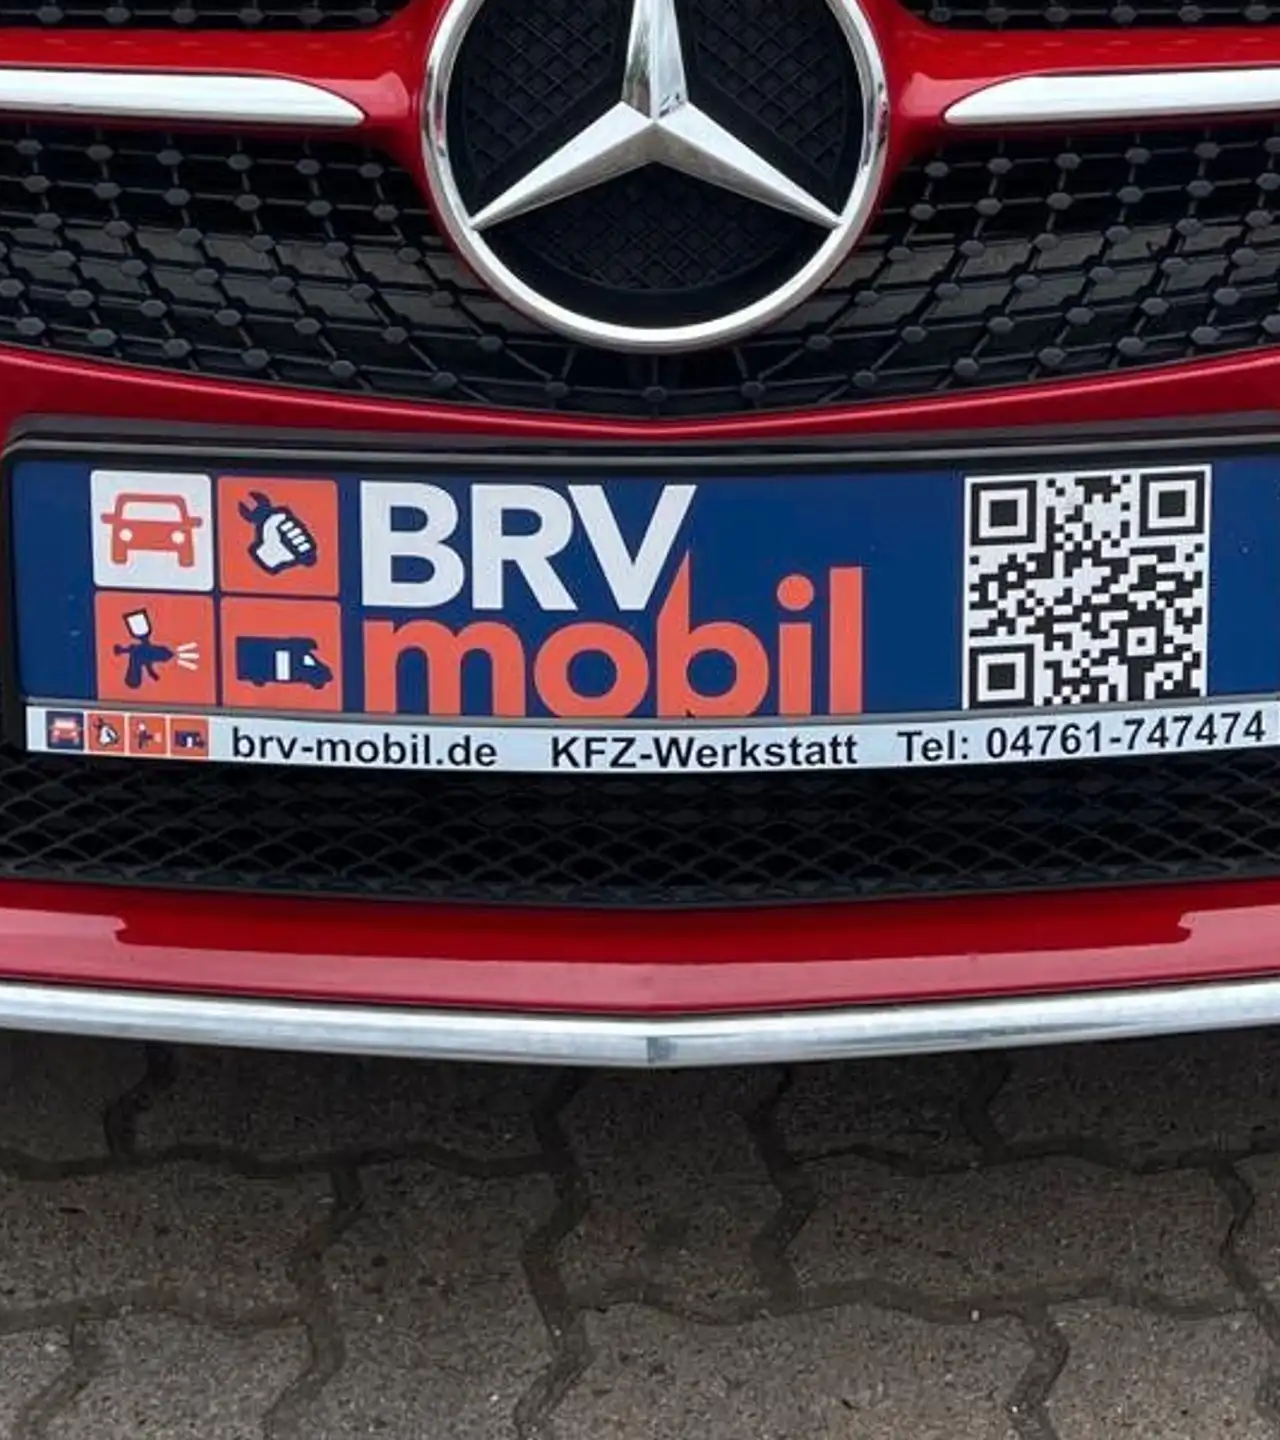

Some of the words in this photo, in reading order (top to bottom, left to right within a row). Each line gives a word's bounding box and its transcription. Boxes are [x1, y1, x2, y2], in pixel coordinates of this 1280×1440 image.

[360, 480, 698, 611] BRV
[363, 550, 863, 717] mobil
[232, 726, 498, 767] brv-mobil.de
[551, 734, 858, 768] KFZ-Werkstatt
[897, 728, 969, 761] Tel:
[986, 710, 1266, 758] 04761-747474
